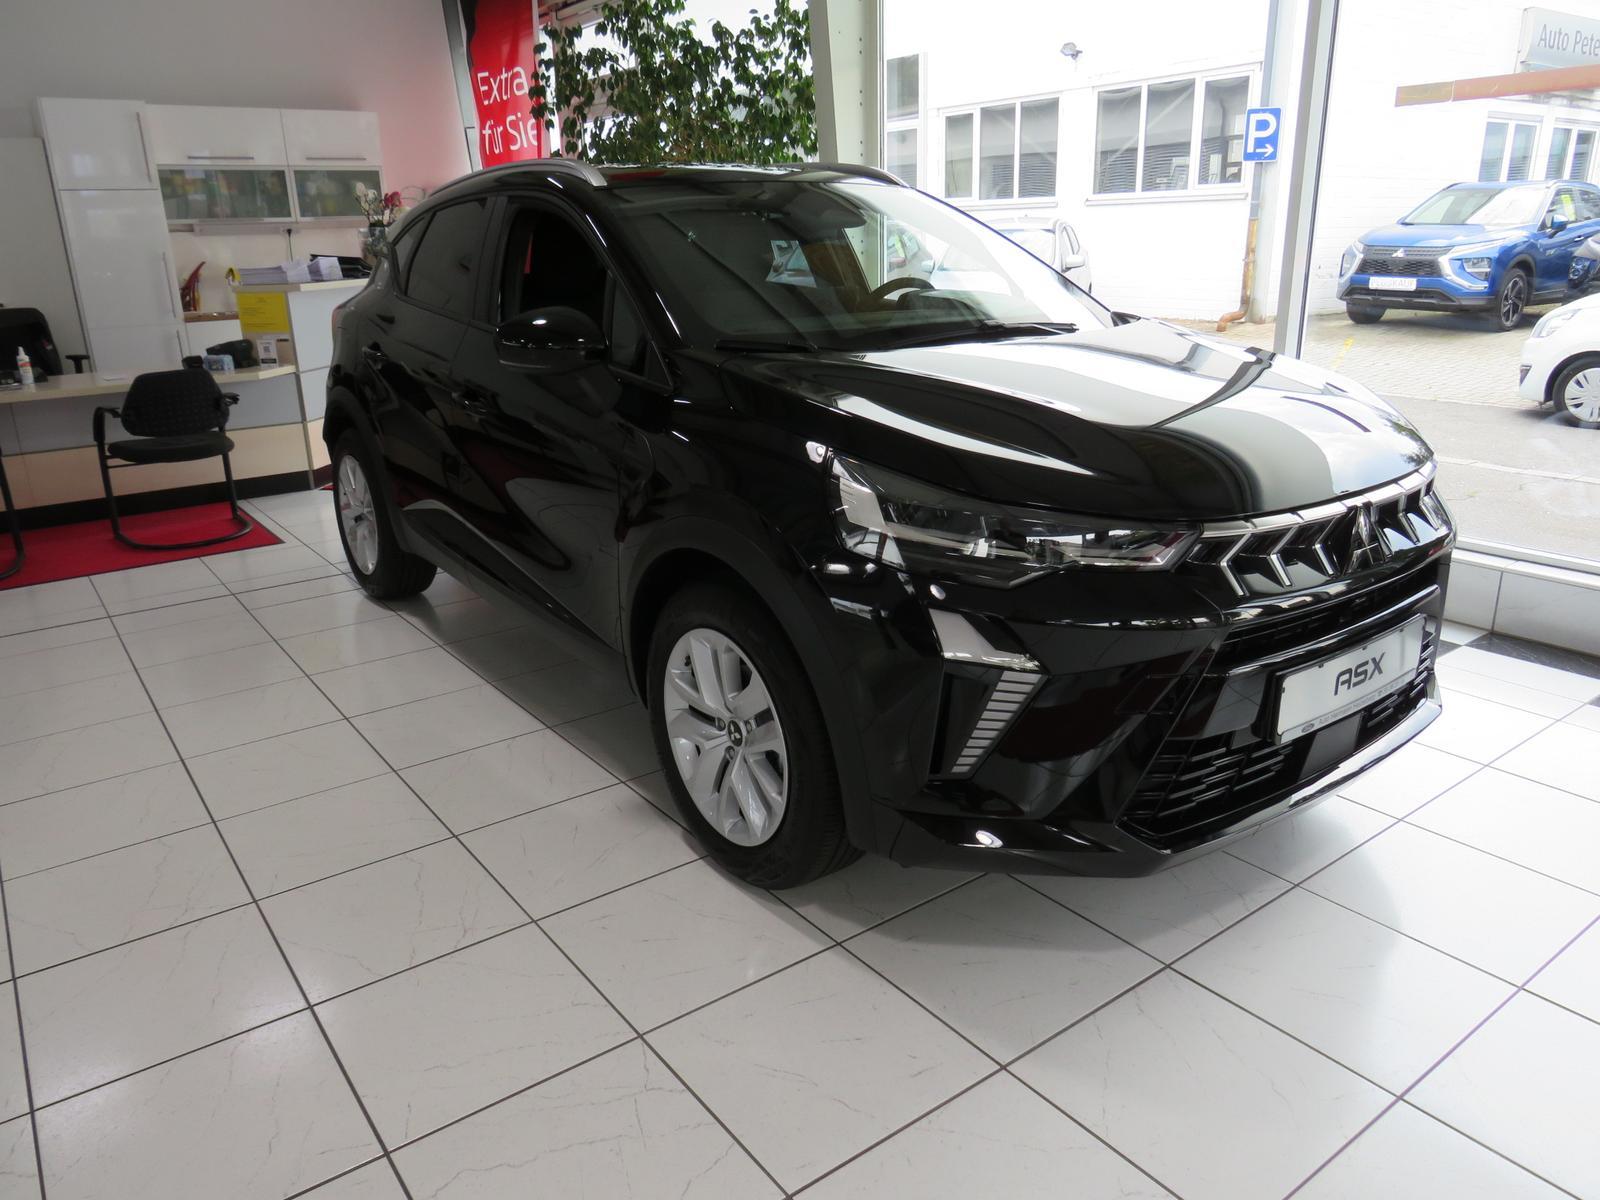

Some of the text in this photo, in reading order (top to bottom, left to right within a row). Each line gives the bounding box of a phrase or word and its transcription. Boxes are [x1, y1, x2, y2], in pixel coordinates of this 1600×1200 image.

[1537, 23, 1570, 52] Auto
[477, 66, 529, 106] Extra
[482, 112, 538, 155] für Sie
[1247, 113, 1277, 153] P
[1333, 651, 1386, 697] ASX
